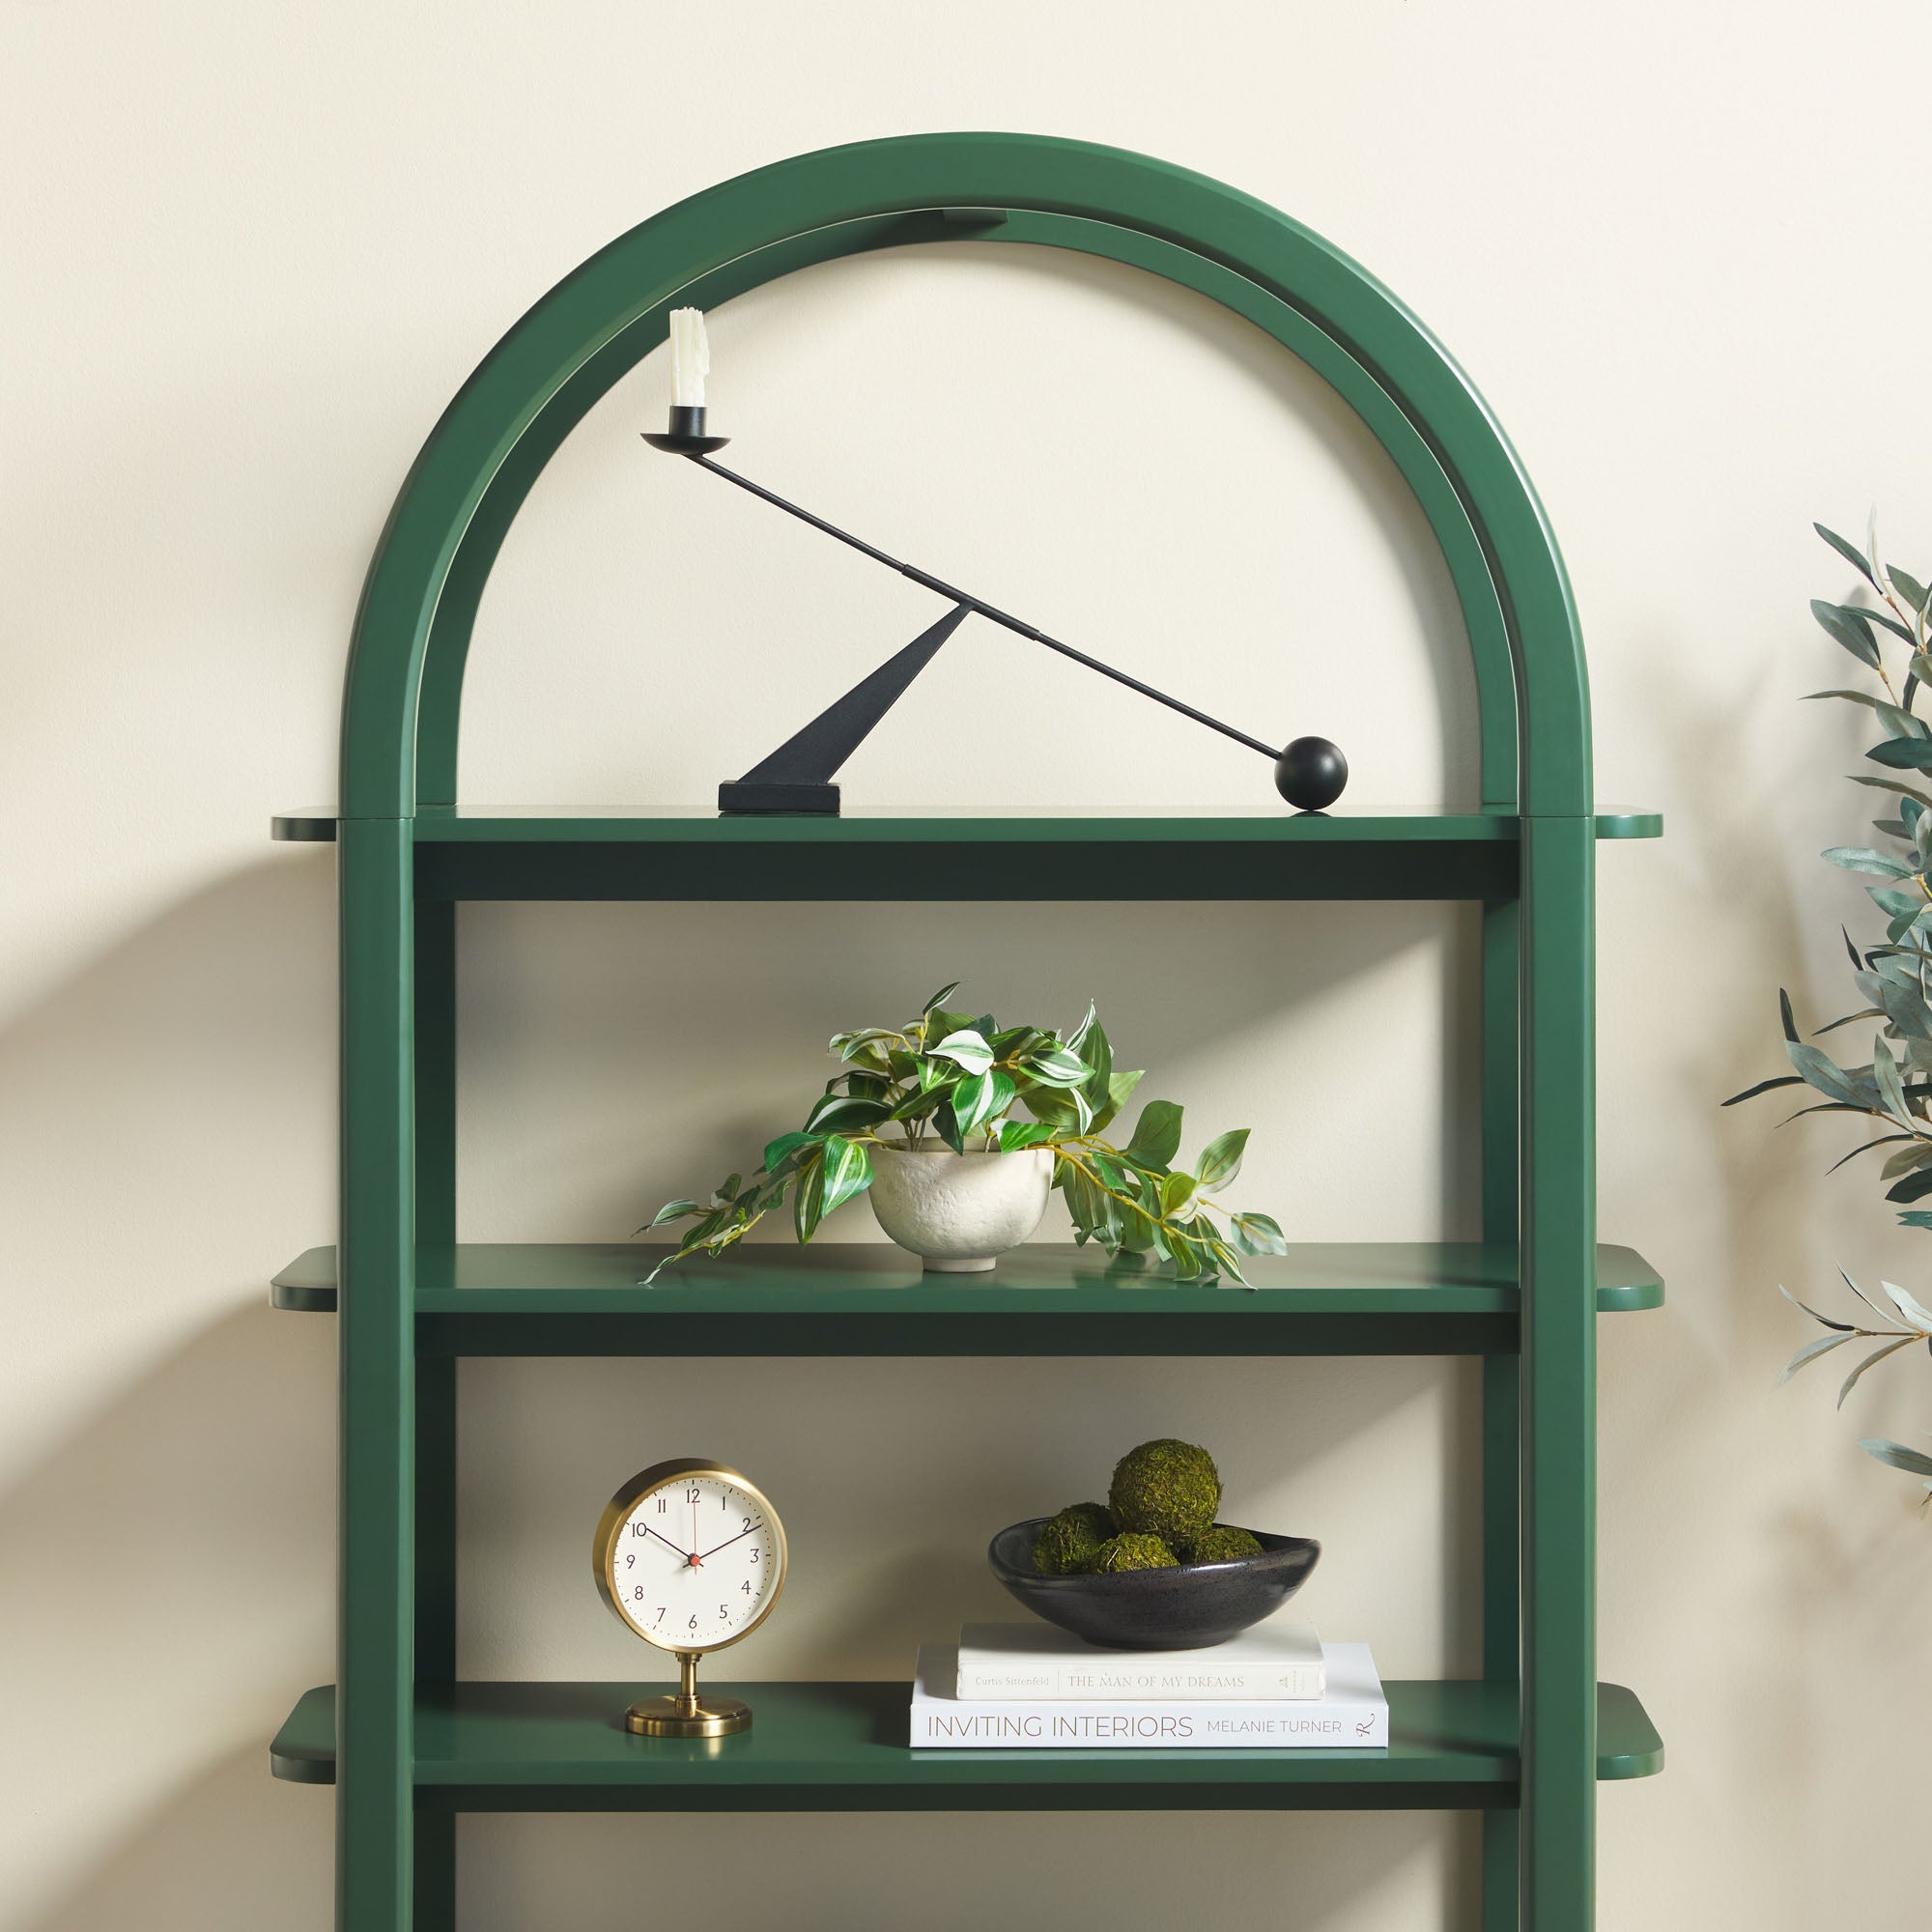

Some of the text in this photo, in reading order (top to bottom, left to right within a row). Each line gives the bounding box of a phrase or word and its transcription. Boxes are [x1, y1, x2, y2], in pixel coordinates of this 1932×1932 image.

[686, 1489, 700, 1503] 12
[657, 1499, 667, 1513] 11
[722, 1496, 725, 1511] 1
[632, 1522, 647, 1537] 10
[742, 1518, 753, 1532] 2
[626, 1555, 636, 1569] 9
[750, 1548, 759, 1563] 3
[634, 1586, 644, 1600] 8
[741, 1580, 752, 1594] 4
[657, 1607, 666, 1622] 7
[719, 1605, 728, 1619] 5
[688, 1614, 697, 1629] 6
[975, 1676, 1049, 1686] Curtis Sittenfeld
[1066, 1676, 1244, 1688] THE MAN OF MY DREAMS
[928, 1717, 1194, 1738] INVITING INTERIORS
[1208, 1720, 1342, 1733] MELANIE TURNER
